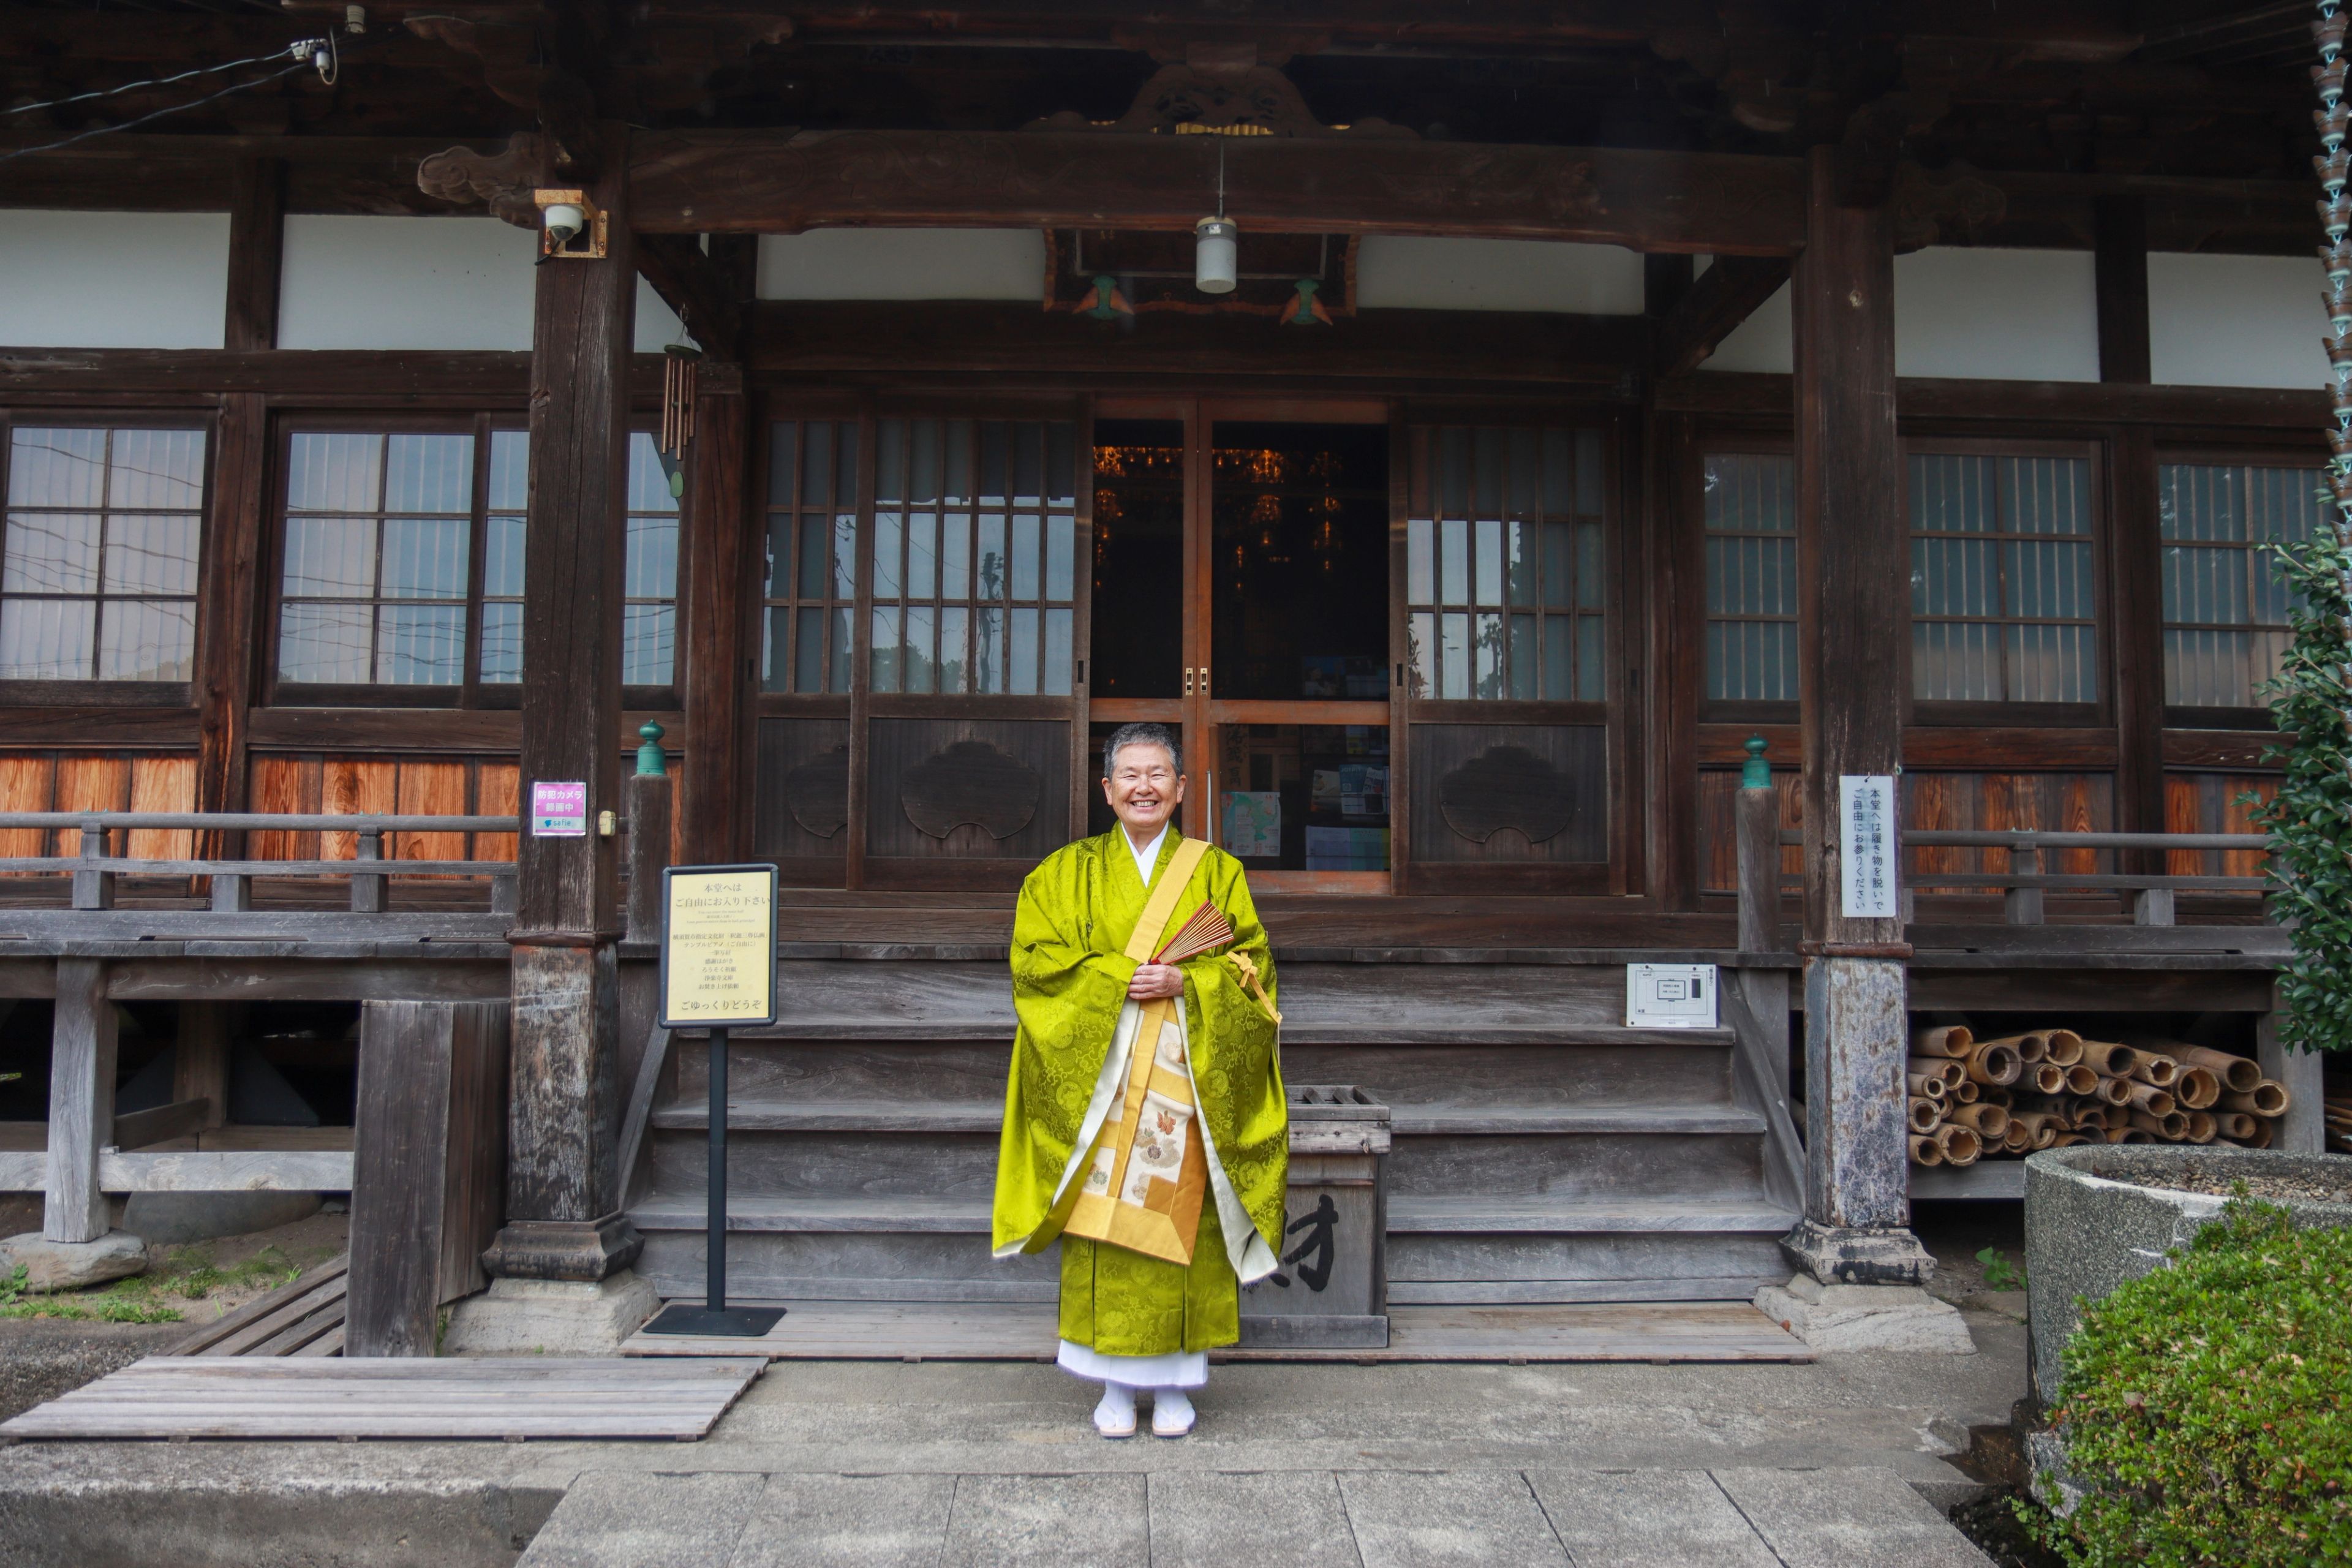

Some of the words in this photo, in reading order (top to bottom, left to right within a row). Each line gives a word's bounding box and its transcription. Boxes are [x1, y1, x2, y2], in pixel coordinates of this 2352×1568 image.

[538, 790, 583, 800] 防犯カメラ
[546, 802, 574, 812] 録画中
[1853, 788, 1866, 910] ご自由にお参りください
[1870, 788, 1884, 910] 本堂へは履き物を脱いで
[704, 883, 742, 893] 本堂へは
[676, 895, 771, 908] ご自由にお入り下さい
[681, 1000, 762, 1011] ごゆっくりどうぞ
